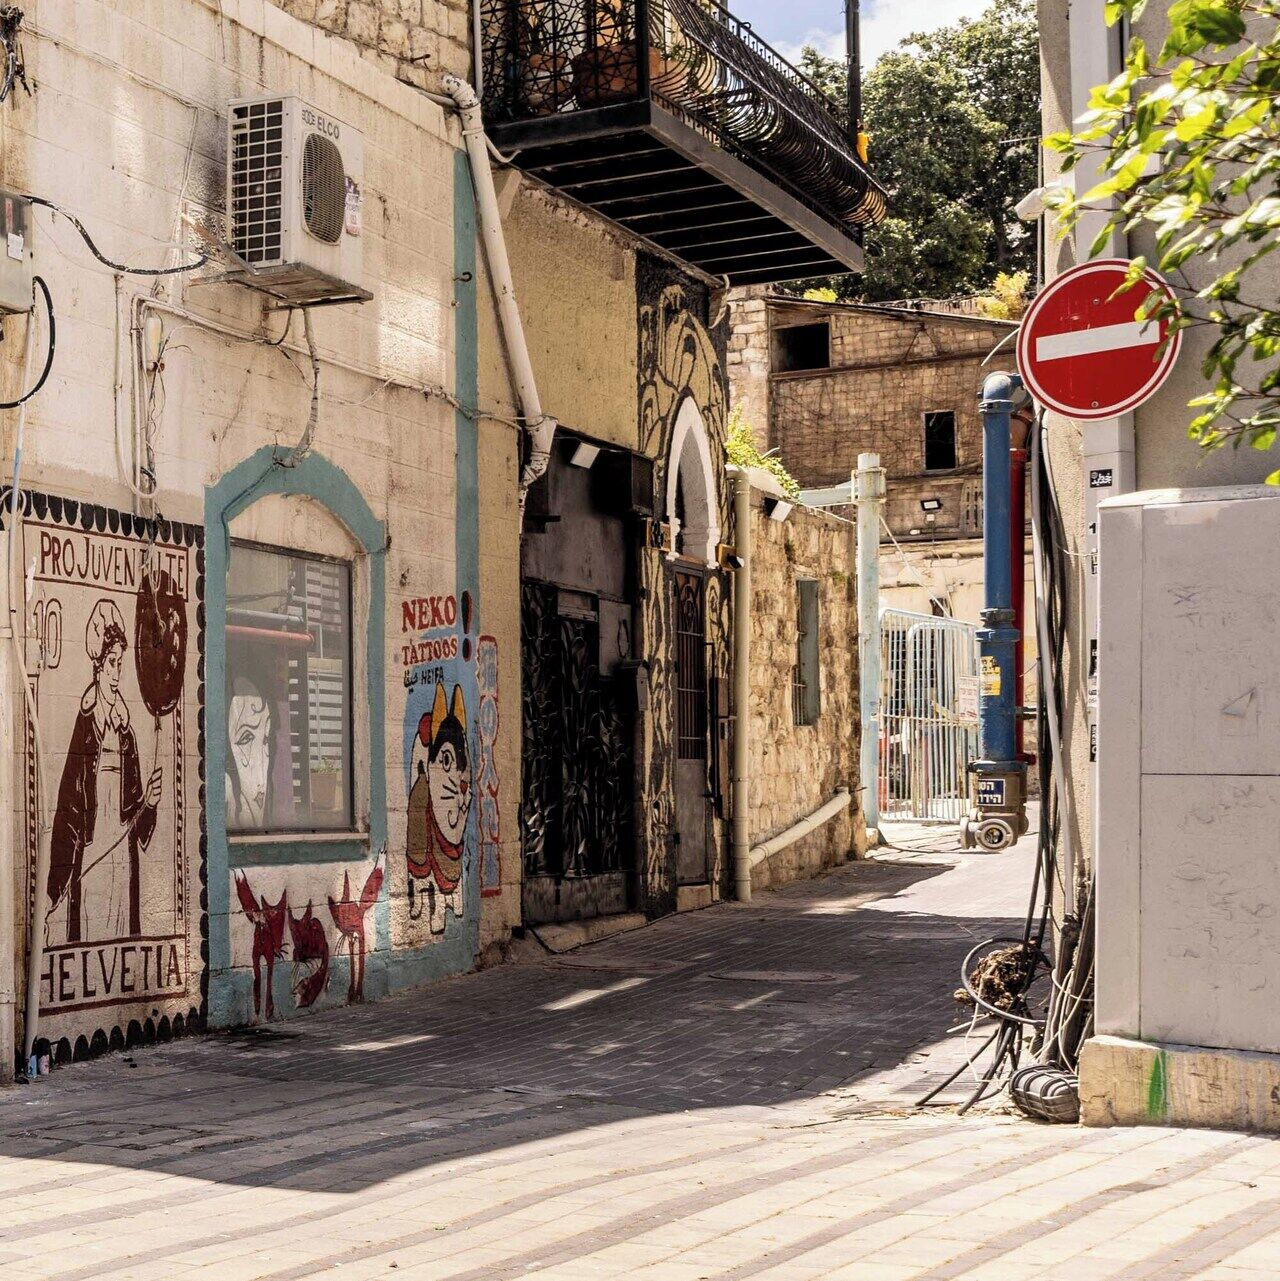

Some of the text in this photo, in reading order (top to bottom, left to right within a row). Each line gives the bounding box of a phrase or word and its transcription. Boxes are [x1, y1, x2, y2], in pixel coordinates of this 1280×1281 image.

[318, 116, 340, 139] ELCO
[401, 595, 457, 633] NEKO
[401, 638, 458, 666] TATTOOS
